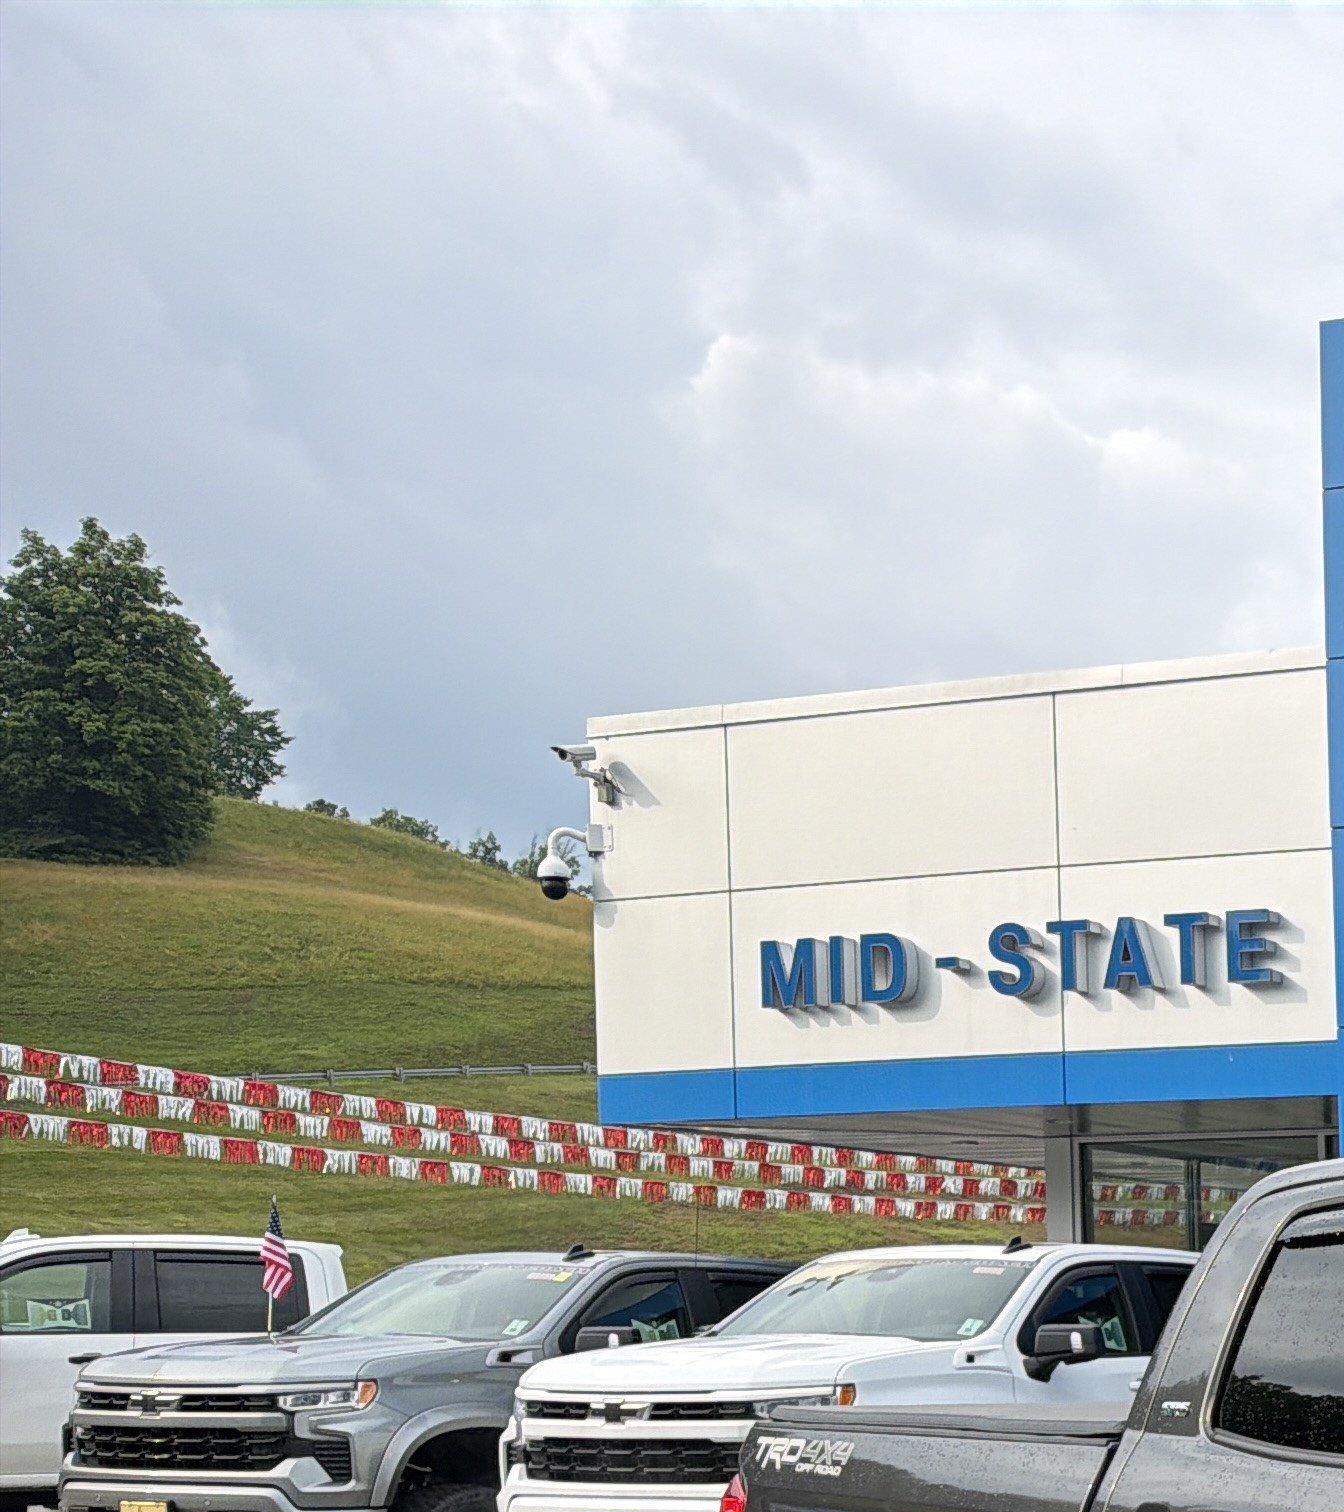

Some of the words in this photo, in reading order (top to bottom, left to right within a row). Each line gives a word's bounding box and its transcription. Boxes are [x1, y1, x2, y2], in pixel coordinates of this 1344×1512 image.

[755, 1436, 807, 1470] TRD
[795, 1463, 815, 1474] OFF
[814, 1464, 842, 1477] ROAD
